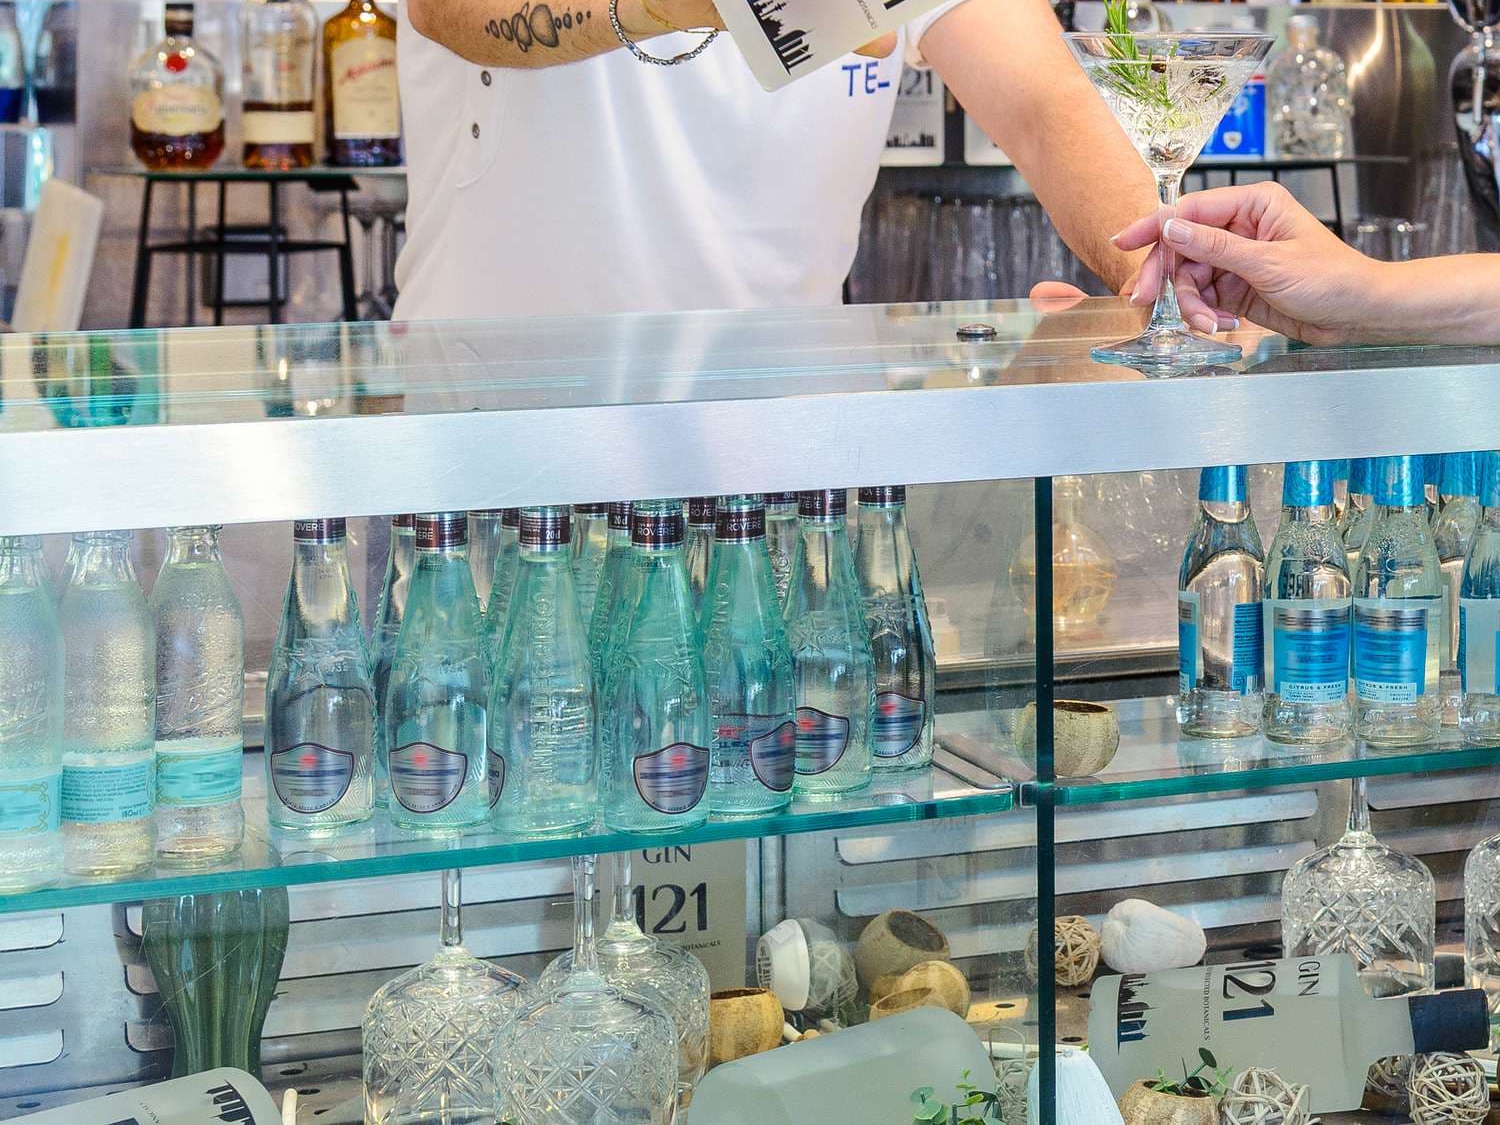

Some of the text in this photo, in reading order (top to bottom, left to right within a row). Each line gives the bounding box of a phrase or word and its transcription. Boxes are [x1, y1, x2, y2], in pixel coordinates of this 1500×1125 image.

[898, 67, 933, 96] 21
[295, 522, 325, 532] OVERE
[637, 526, 676, 537] ROVERE
[642, 844, 692, 864] GIN
[631, 882, 708, 934] 121
[1222, 961, 1277, 1022] 121
[1298, 961, 1321, 997] GIN
